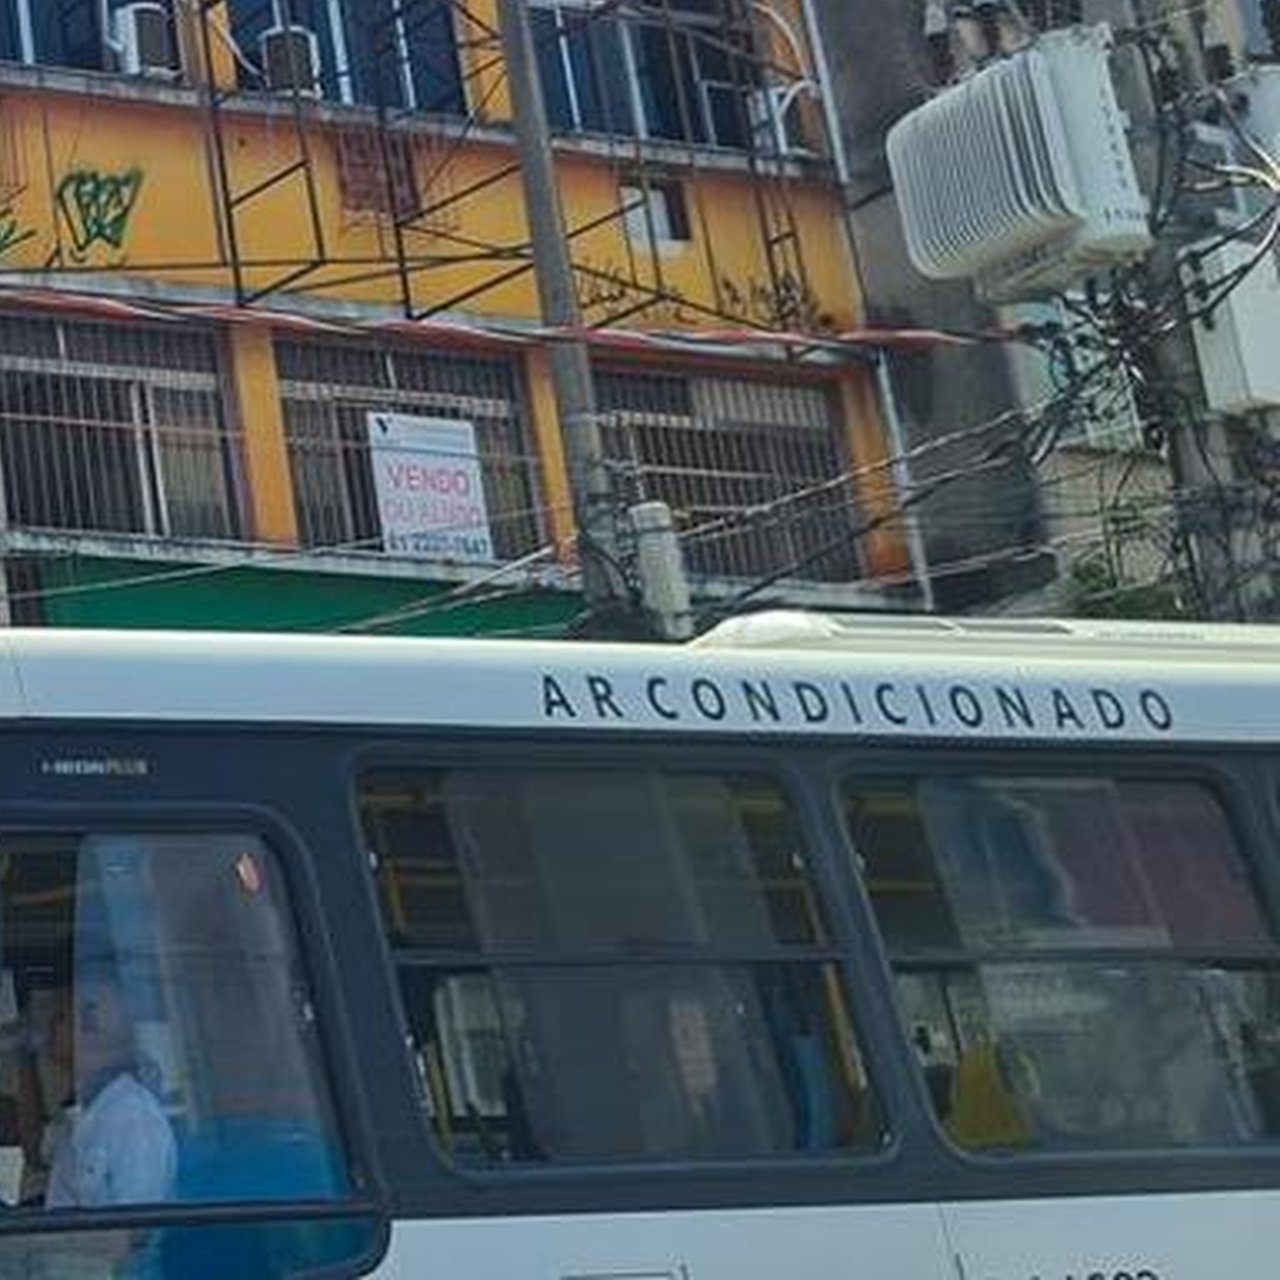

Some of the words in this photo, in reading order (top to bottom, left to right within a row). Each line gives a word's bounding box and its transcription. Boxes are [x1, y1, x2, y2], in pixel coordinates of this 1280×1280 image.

[388, 463, 470, 496] VENDO
[541, 673, 620, 719] AR
[645, 676, 1175, 731] CONDICIONADO
